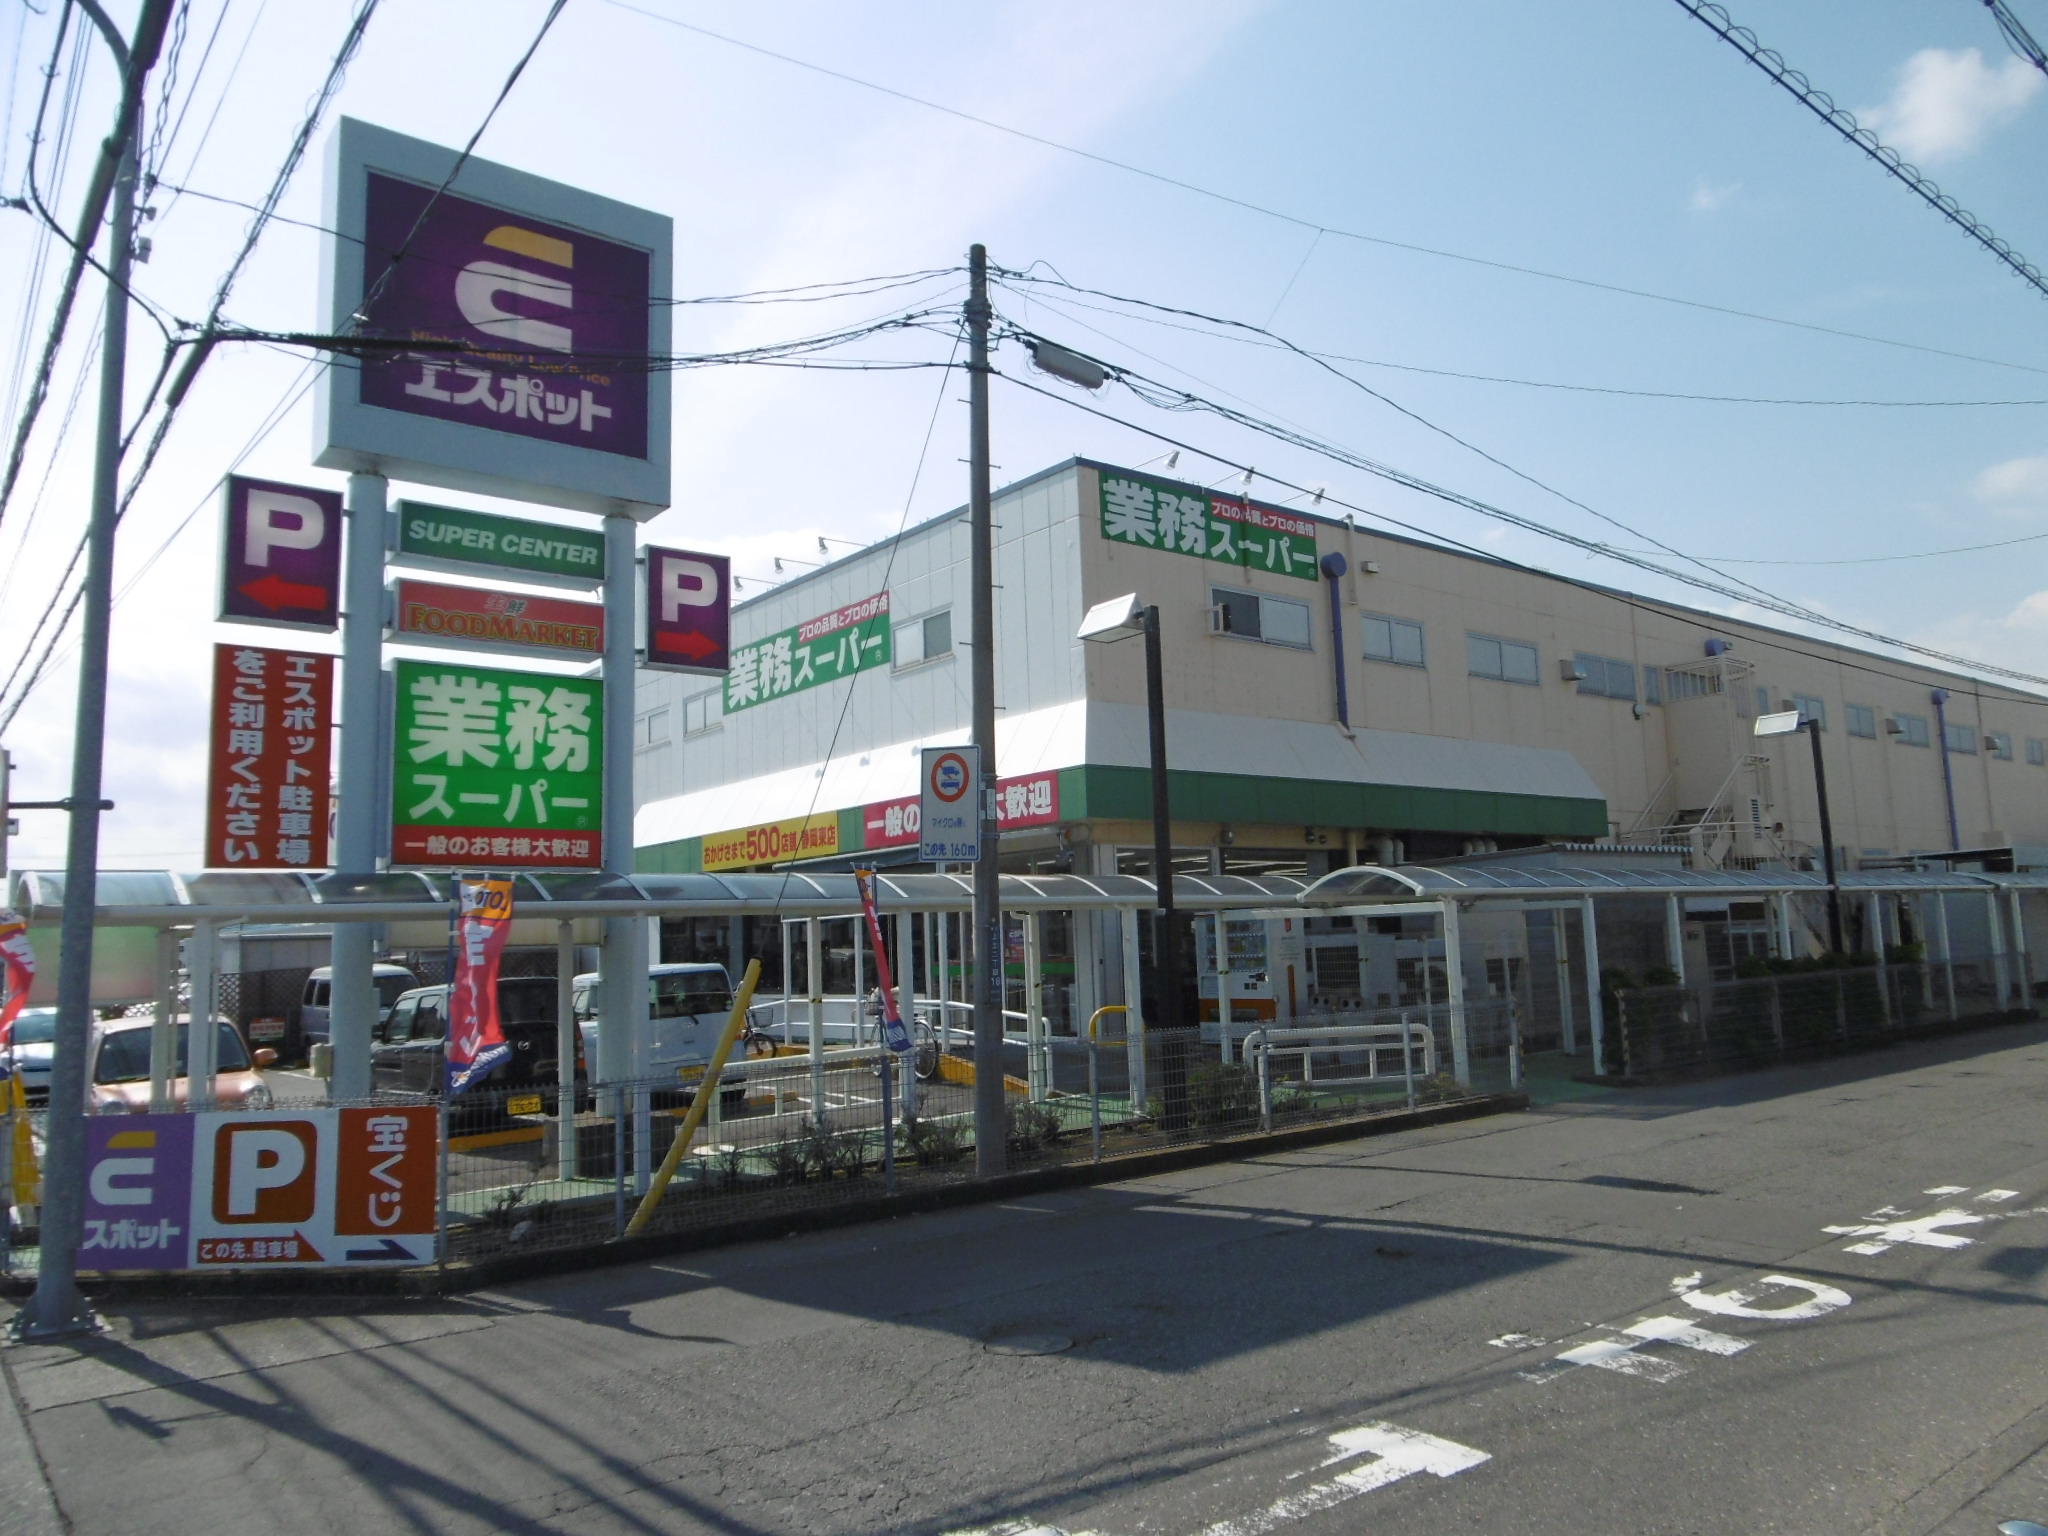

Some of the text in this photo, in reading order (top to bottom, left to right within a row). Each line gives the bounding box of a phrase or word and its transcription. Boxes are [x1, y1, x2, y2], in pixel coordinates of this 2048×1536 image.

[404, 352, 612, 432] エスポット
[245, 488, 324, 567] P
[409, 519, 599, 565] SUPER CENTER
[1102, 479, 1315, 574] 業務スーパー
[661, 556, 718, 622] P
[799, 594, 888, 641] プロの品質とプロの価格
[728, 627, 882, 709] 業務スーパー
[223, 649, 267, 863] をご利用ください
[276, 655, 316, 865] エスポット駐車場
[408, 674, 591, 772] 業務
[408, 773, 589, 824] スーパー
[404, 835, 590, 858] 一般のお客様大歓迎
[924, 842, 976, 857] この先 160m
[228, 1130, 305, 1216] P
[366, 1115, 408, 1227] 宝くじ
